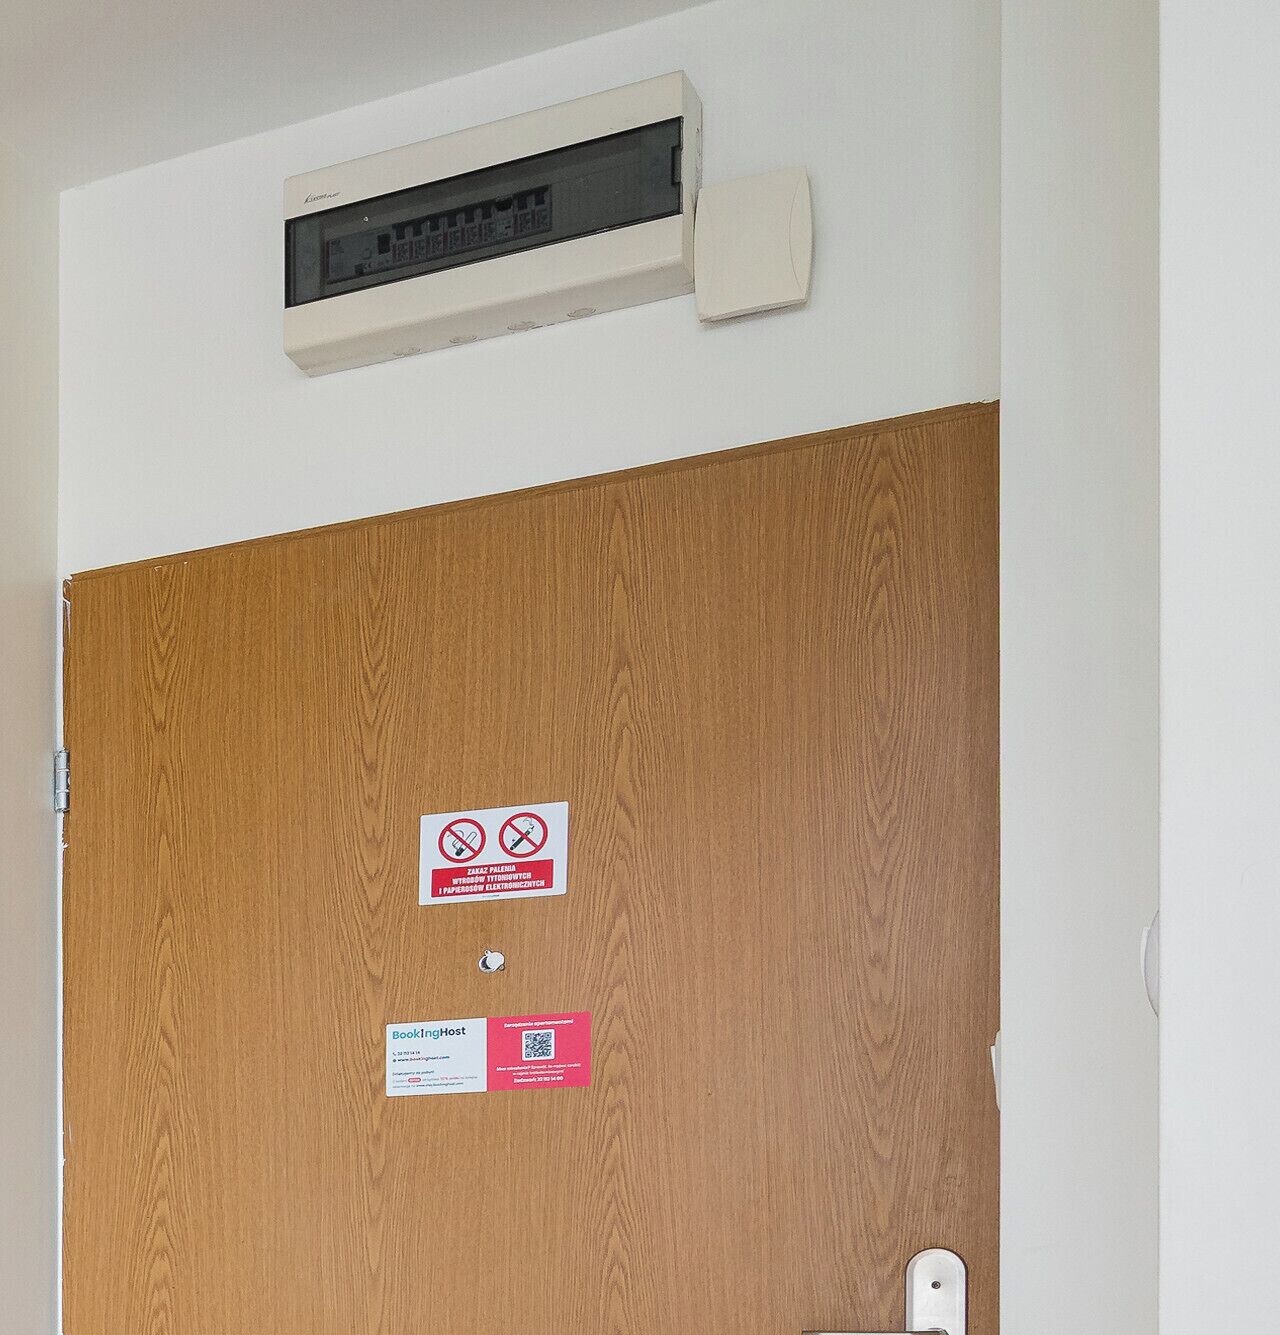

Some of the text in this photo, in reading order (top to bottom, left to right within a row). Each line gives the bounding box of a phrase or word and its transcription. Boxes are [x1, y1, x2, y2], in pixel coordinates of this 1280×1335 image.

[467, 865, 516, 875] ZAKAZ PALENIA
[452, 872, 531, 885] WYROBÓW TYTONIOWYCH
[443, 884, 484, 894] PAPIEROSÓW
[485, 880, 545, 891] ELEKTRONICZNYCH
